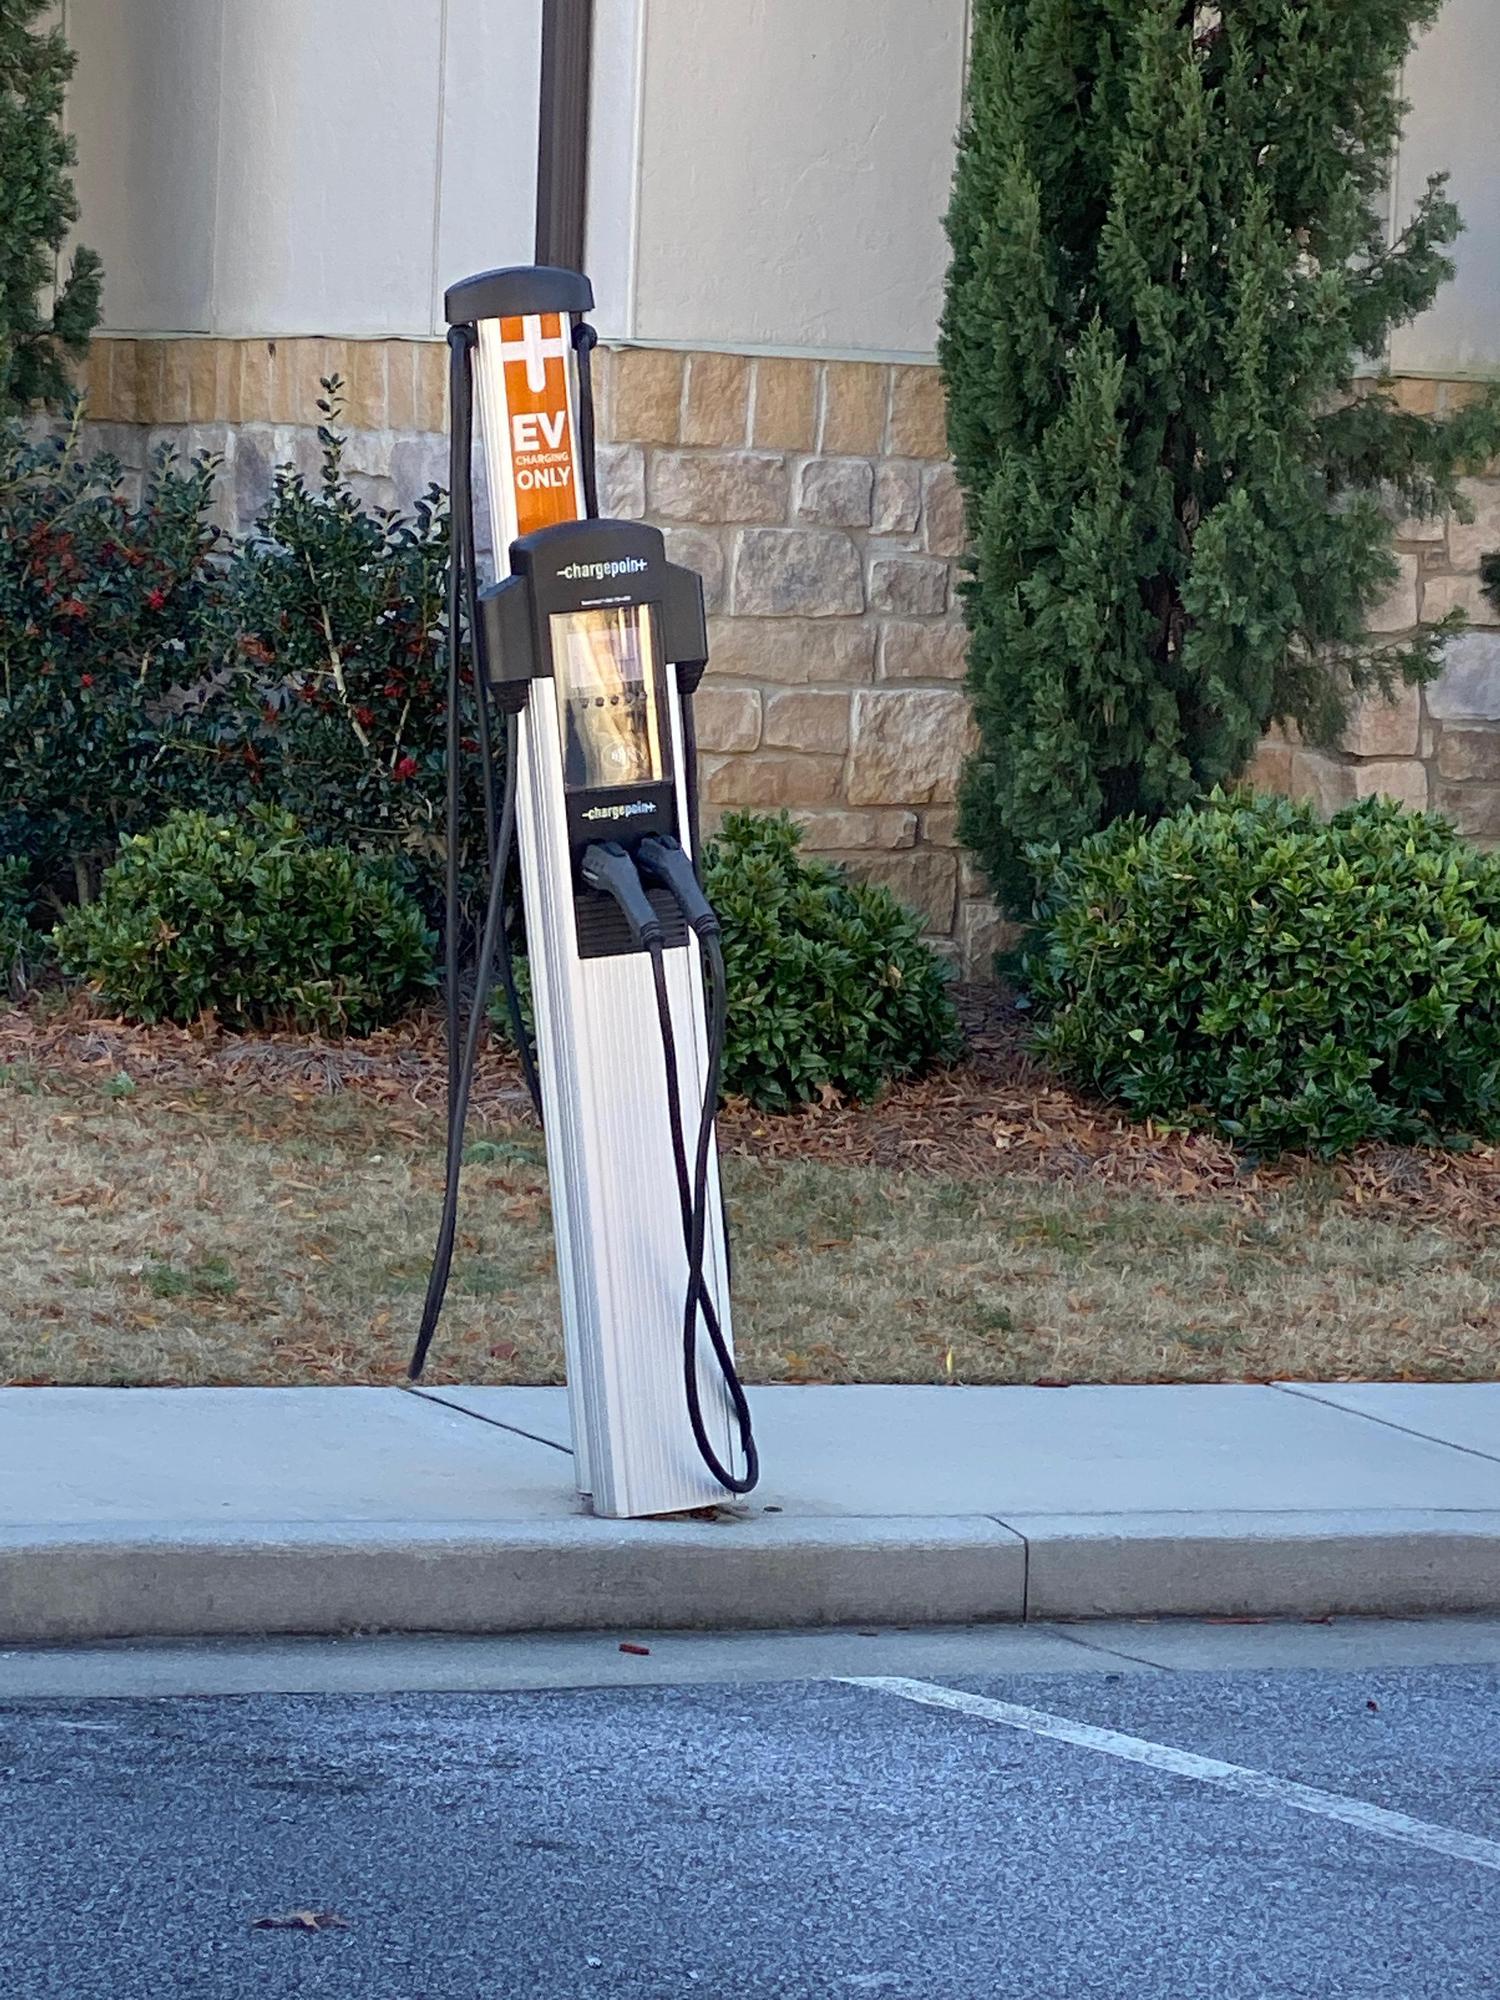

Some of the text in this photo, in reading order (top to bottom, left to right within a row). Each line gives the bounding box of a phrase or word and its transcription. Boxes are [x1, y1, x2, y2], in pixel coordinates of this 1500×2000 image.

[512, 411, 566, 452] EV
[515, 452, 569, 466] CHARGING
[516, 465, 571, 490] ONLY
